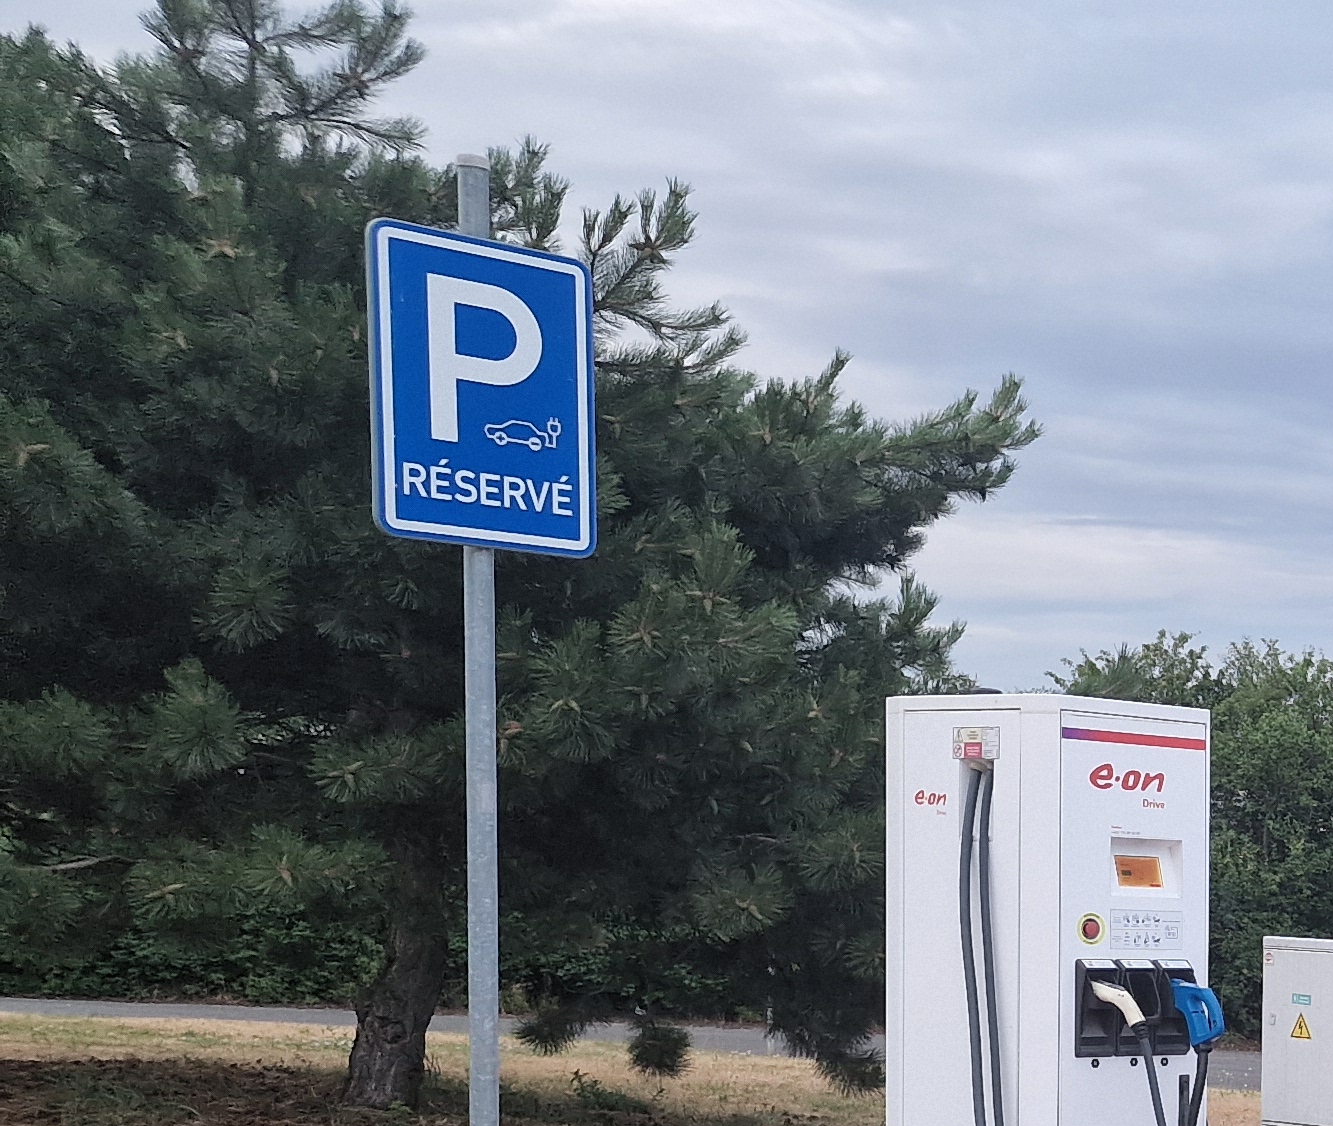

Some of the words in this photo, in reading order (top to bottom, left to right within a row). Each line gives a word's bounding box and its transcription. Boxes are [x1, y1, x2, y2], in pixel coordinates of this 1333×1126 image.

[427, 272, 543, 443] P
[402, 459, 573, 517] RÉSERVÉ
[1142, 798, 1165, 809] Drive
